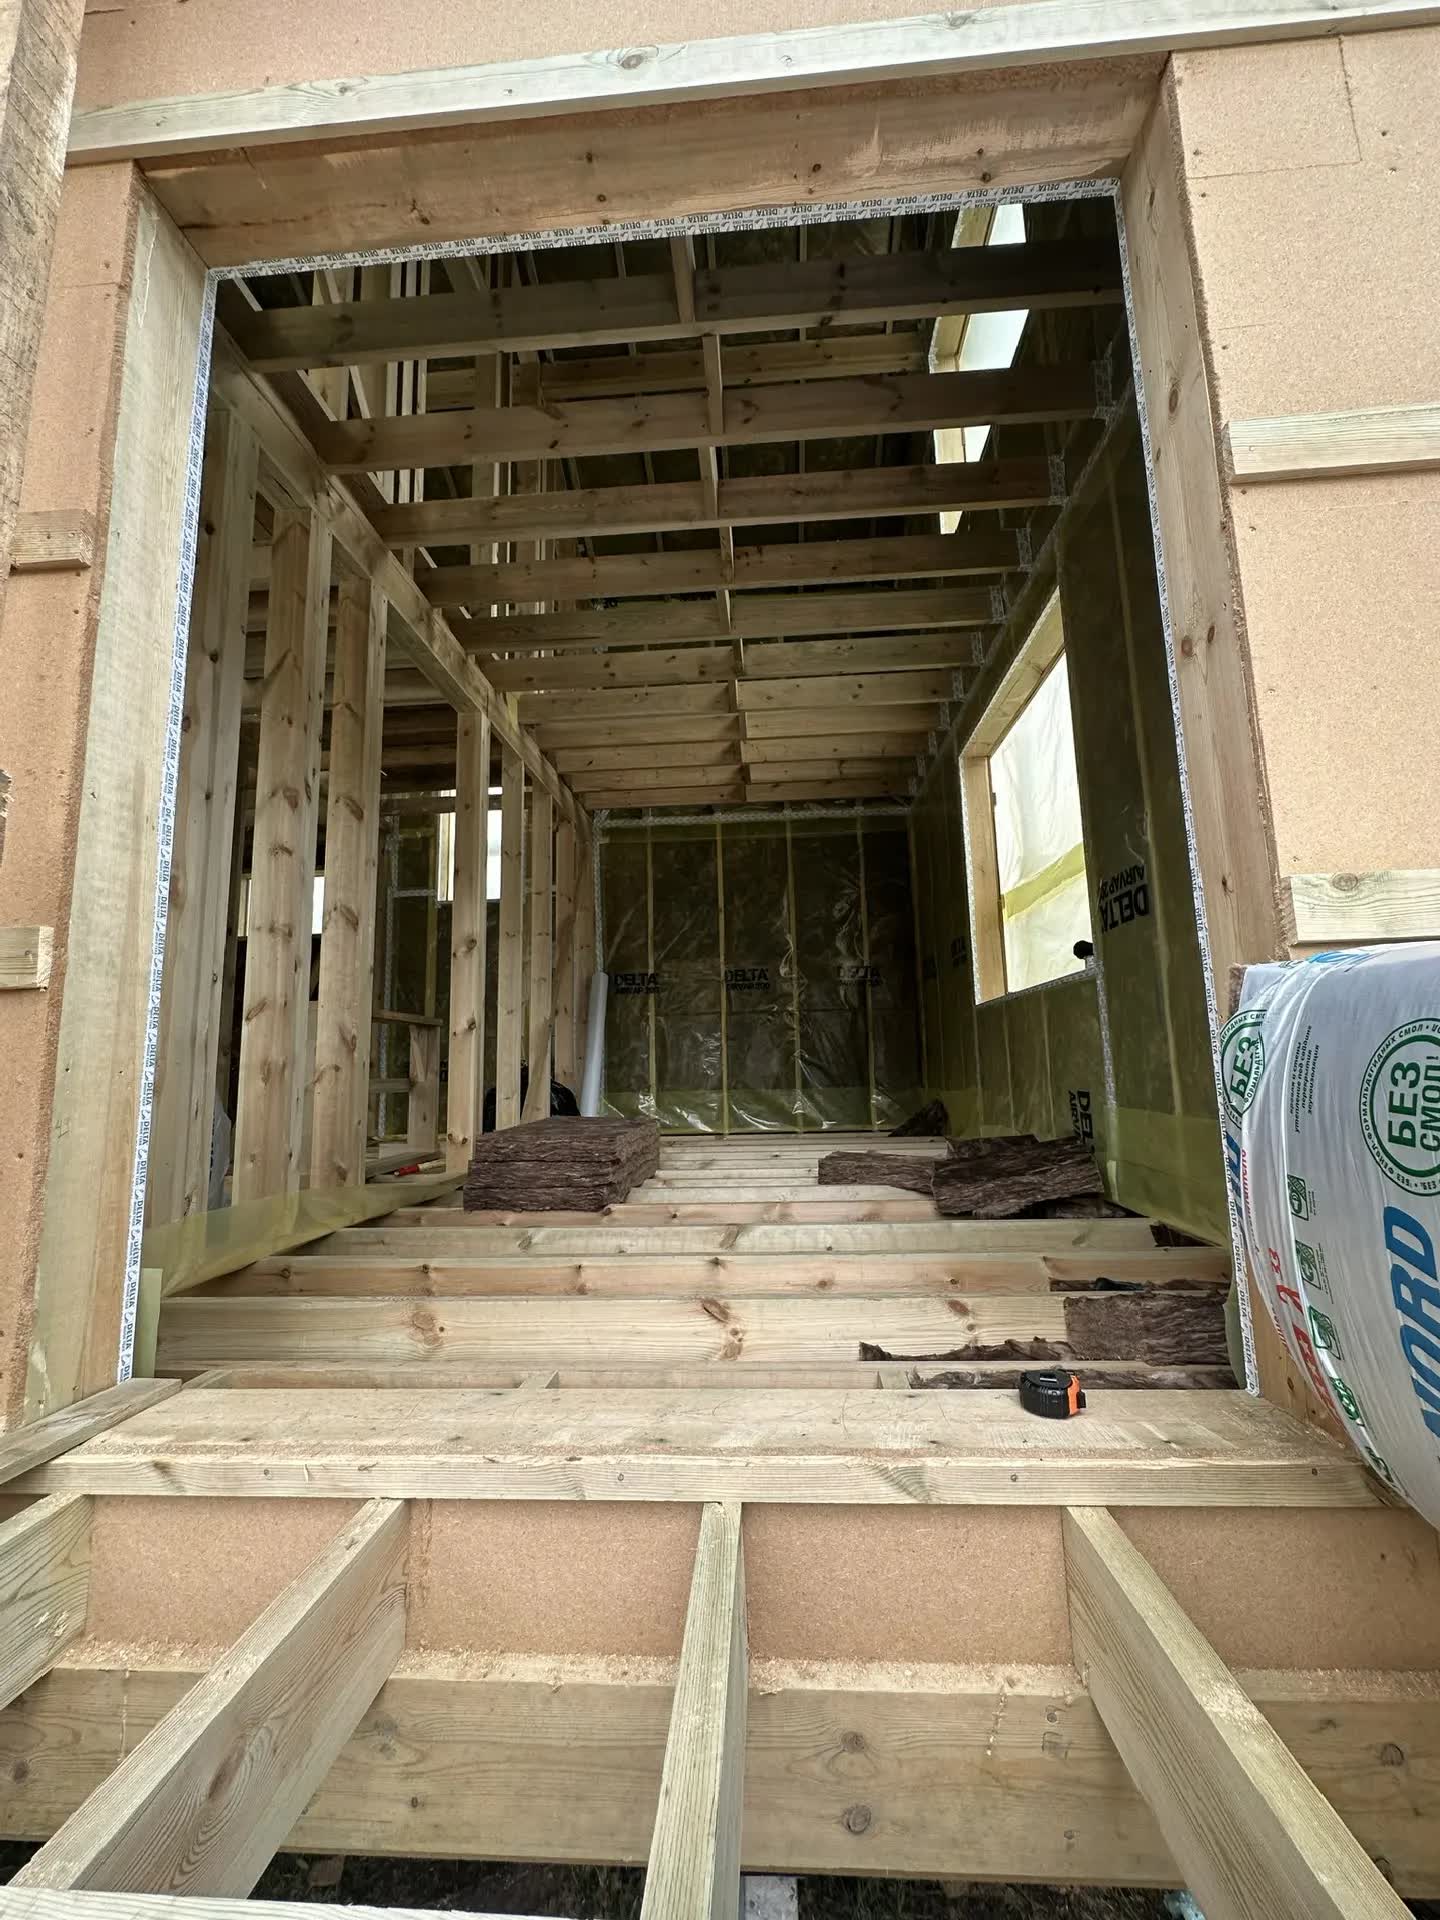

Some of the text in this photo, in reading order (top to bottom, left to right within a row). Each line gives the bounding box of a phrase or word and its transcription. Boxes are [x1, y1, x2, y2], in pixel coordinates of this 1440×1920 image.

[1038, 183, 1059, 191] DELTA
[1074, 180, 1095, 188] DELTA
[967, 189, 987, 197] DELTA
[1002, 186, 1024, 194] DELTA
[861, 199, 882, 207] DELTA
[896, 195, 917, 204] DELTA
[791, 205, 812, 213] DELTA
[826, 202, 847, 210] DELTA
[722, 211, 743, 219] DELTA
[756, 208, 778, 216] DELTA
[620, 221, 640, 229] DELTA
[654, 218, 674, 226] DELTA
[552, 228, 573, 236] DELTA
[586, 225, 607, 233] DELTA
[487, 235, 507, 243] DELTA
[519, 231, 541, 239] DELTA
[422, 242, 442, 250] DELTA
[454, 238, 475, 247] DELTA
[357, 249, 378, 258] DELTA
[389, 246, 410, 254] DELTA
[325, 253, 346, 261] DELTA
[159, 896, 167, 917] DELTA
[1100, 884, 1148, 933] DELTA
[726, 968, 768, 981] DELTA
[154, 969, 162, 991] DELTA
[614, 973, 658, 986] DELTA
[151, 1006, 159, 1029] DELTA
[148, 1044, 156, 1066] DELTA
[1387, 1061, 1421, 1148] БЕЗ
[1077, 1090, 1095, 1147] DEL
[135, 1200, 143, 1225] DELTA
[132, 1240, 140, 1266] DELTA
[128, 1281, 136, 1307] DELTA
[125, 1322, 133, 1349] DELTA
